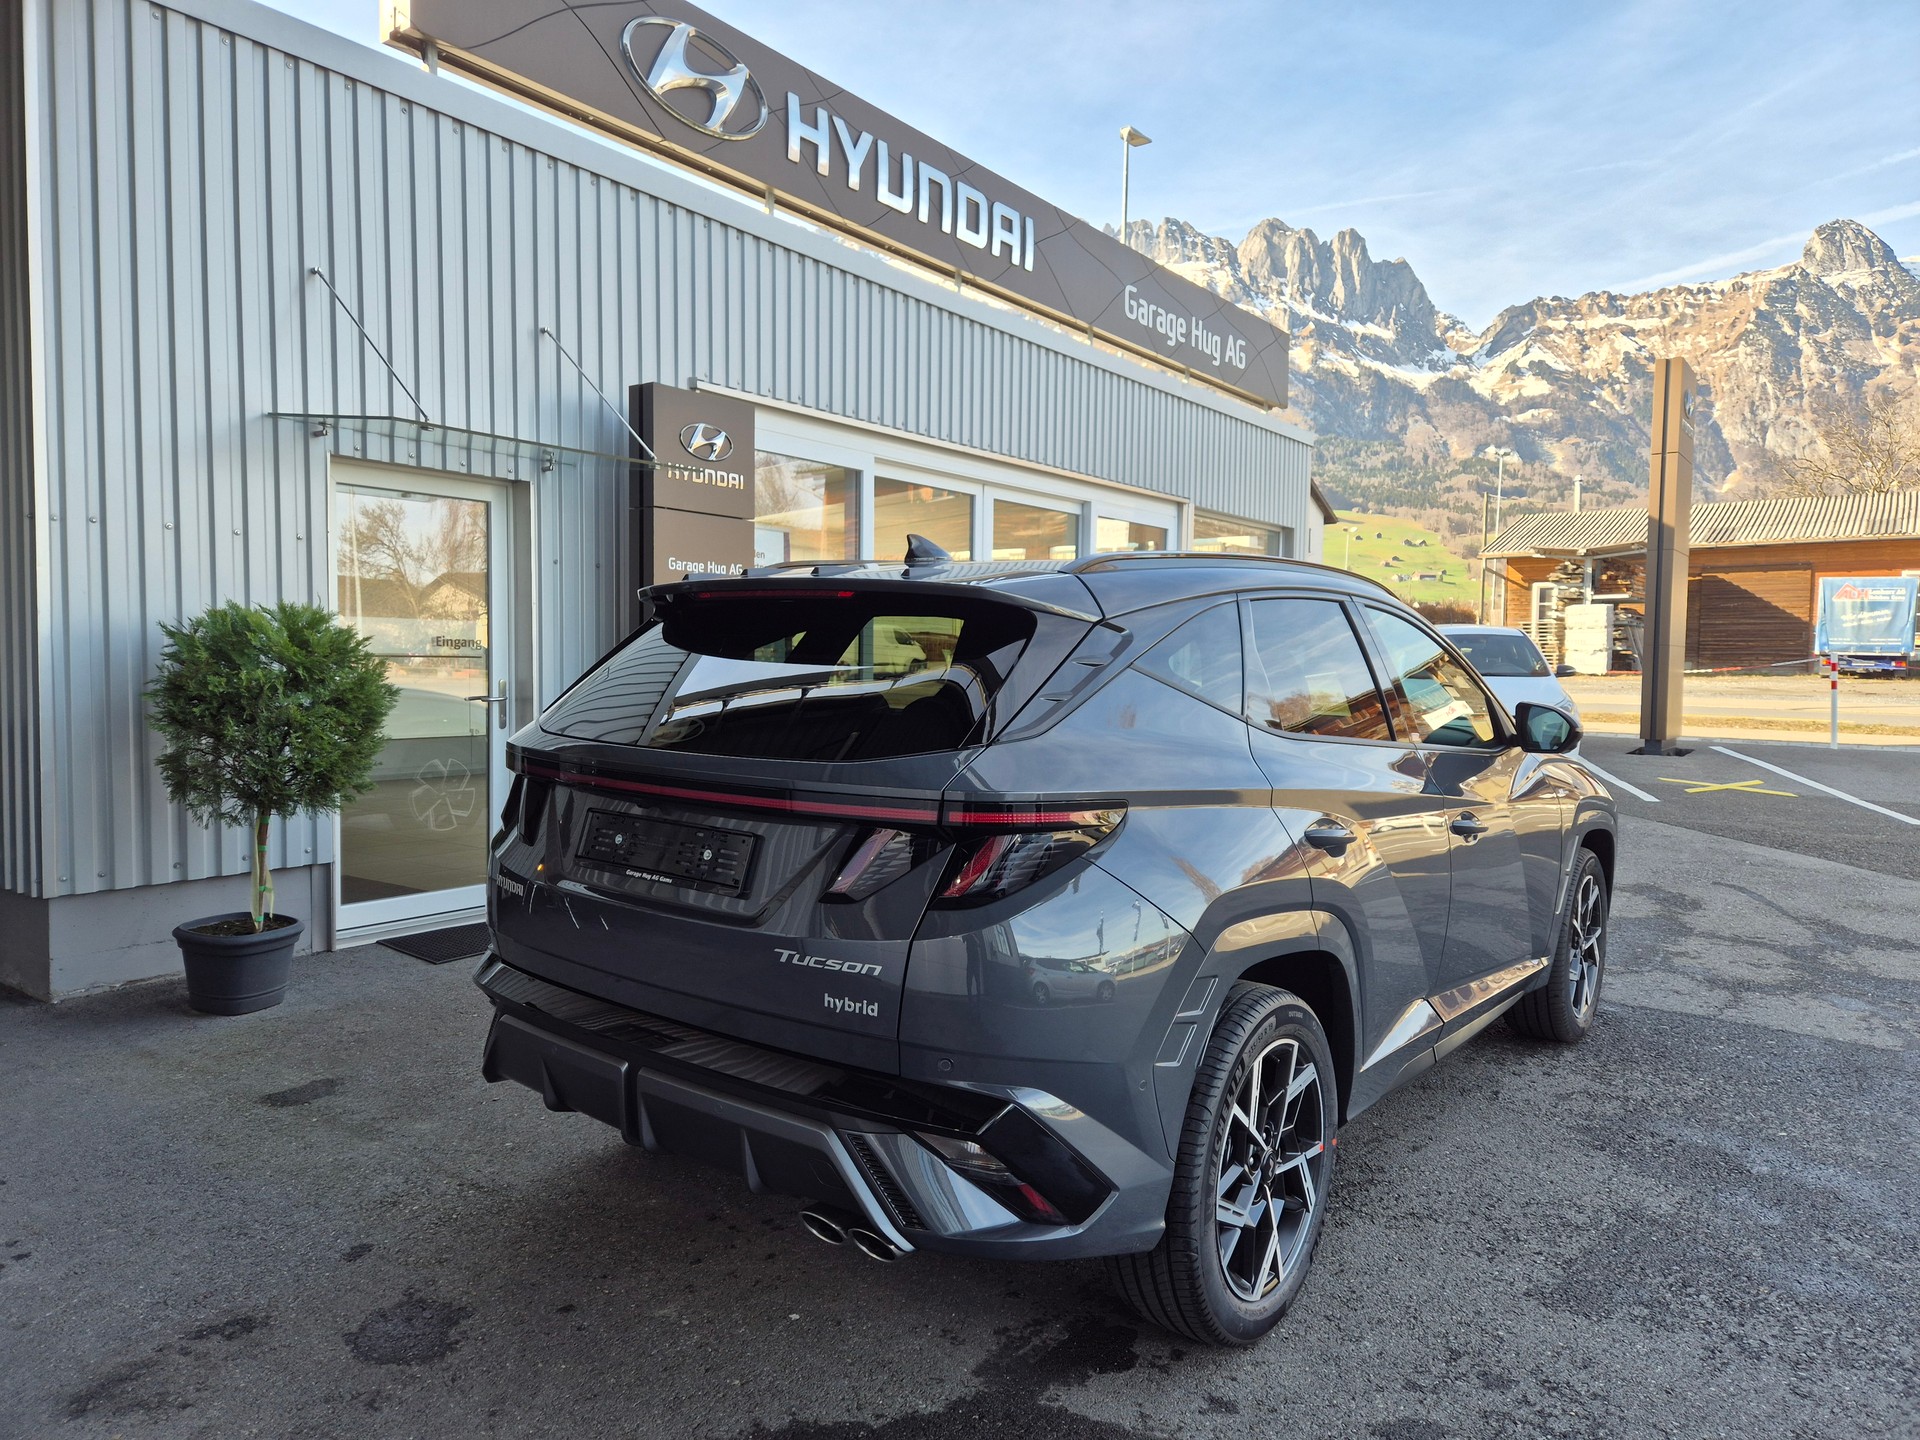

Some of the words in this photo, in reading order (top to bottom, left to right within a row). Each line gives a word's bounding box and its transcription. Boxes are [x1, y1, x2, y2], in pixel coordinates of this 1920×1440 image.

[787, 92, 1035, 272] HYUNDAI
[1124, 284, 1187, 346] Garage
[1191, 316, 1221, 366] Hug
[1225, 334, 1246, 370] AG
[667, 462, 744, 489] HYUNDAI
[668, 557, 705, 574] Garage
[729, 563, 743, 576] AG
[435, 635, 482, 651] Eingang
[496, 873, 524, 896] HYUNDAI
[626, 869, 642, 878] Garage
[642, 872, 652, 881] Hug
[824, 993, 879, 1017] hybrid
[1208, 1063, 1246, 1187] MICHELIN
